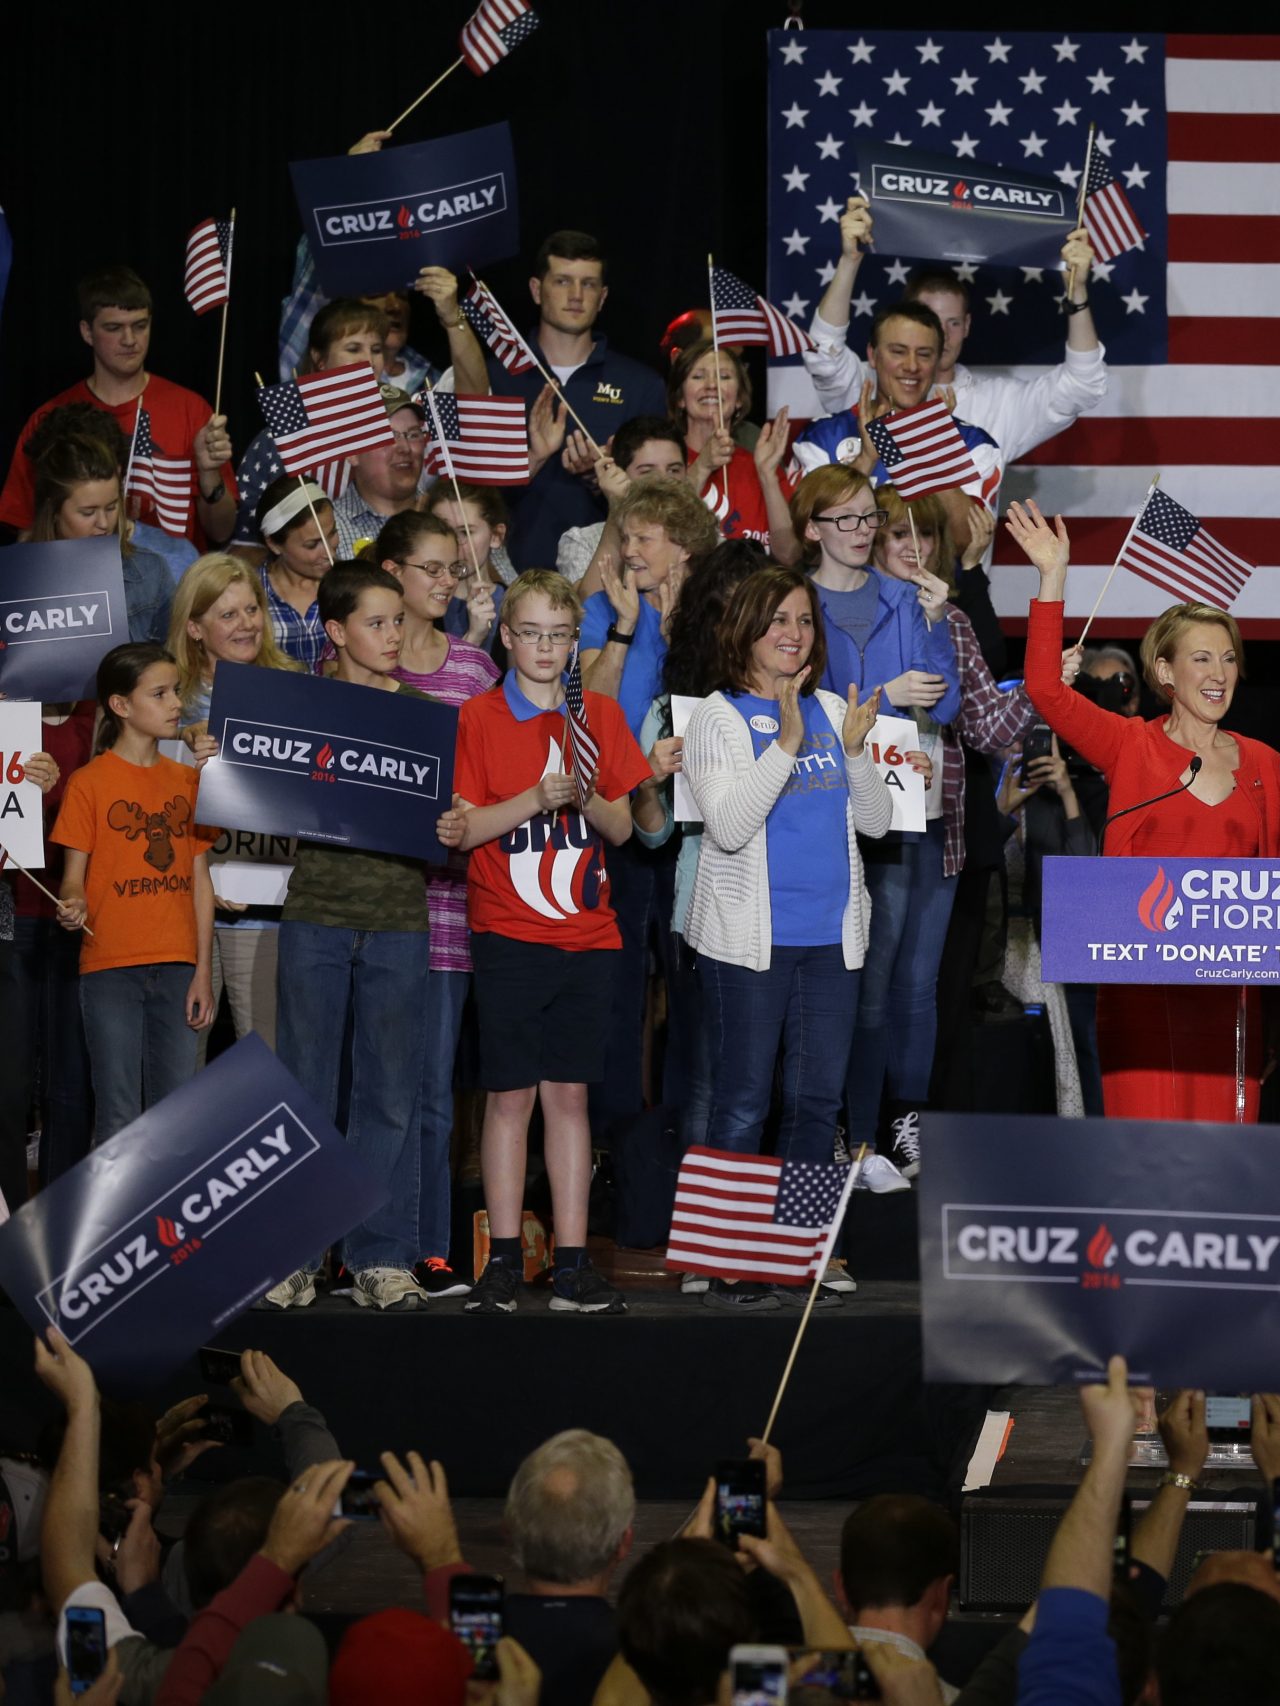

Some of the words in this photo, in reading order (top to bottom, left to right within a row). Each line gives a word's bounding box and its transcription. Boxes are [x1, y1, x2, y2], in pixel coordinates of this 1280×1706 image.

[881, 173, 949, 196] CRUZ
[973, 184, 1053, 207] CARLY
[325, 210, 394, 235] CRUZ
[417, 186, 497, 223] CARLY
[597, 382, 621, 400] MU
[5, 604, 99, 634] CARLY
[232, 732, 312, 764] CRUZ
[339, 750, 430, 785] CARLY
[311, 770, 336, 783] 2016
[1087, 943, 1149, 961] TEXT
[1155, 943, 1267, 963] 'DONATE'
[1194, 968, 1280, 980] CruzCarly.com
[60, 1234, 160, 1319] CRUZ
[181, 1124, 292, 1224] CARLY
[170, 1237, 204, 1266] 2016
[957, 1224, 1079, 1265] CRUZ
[1124, 1229, 1280, 1272] CARLY
